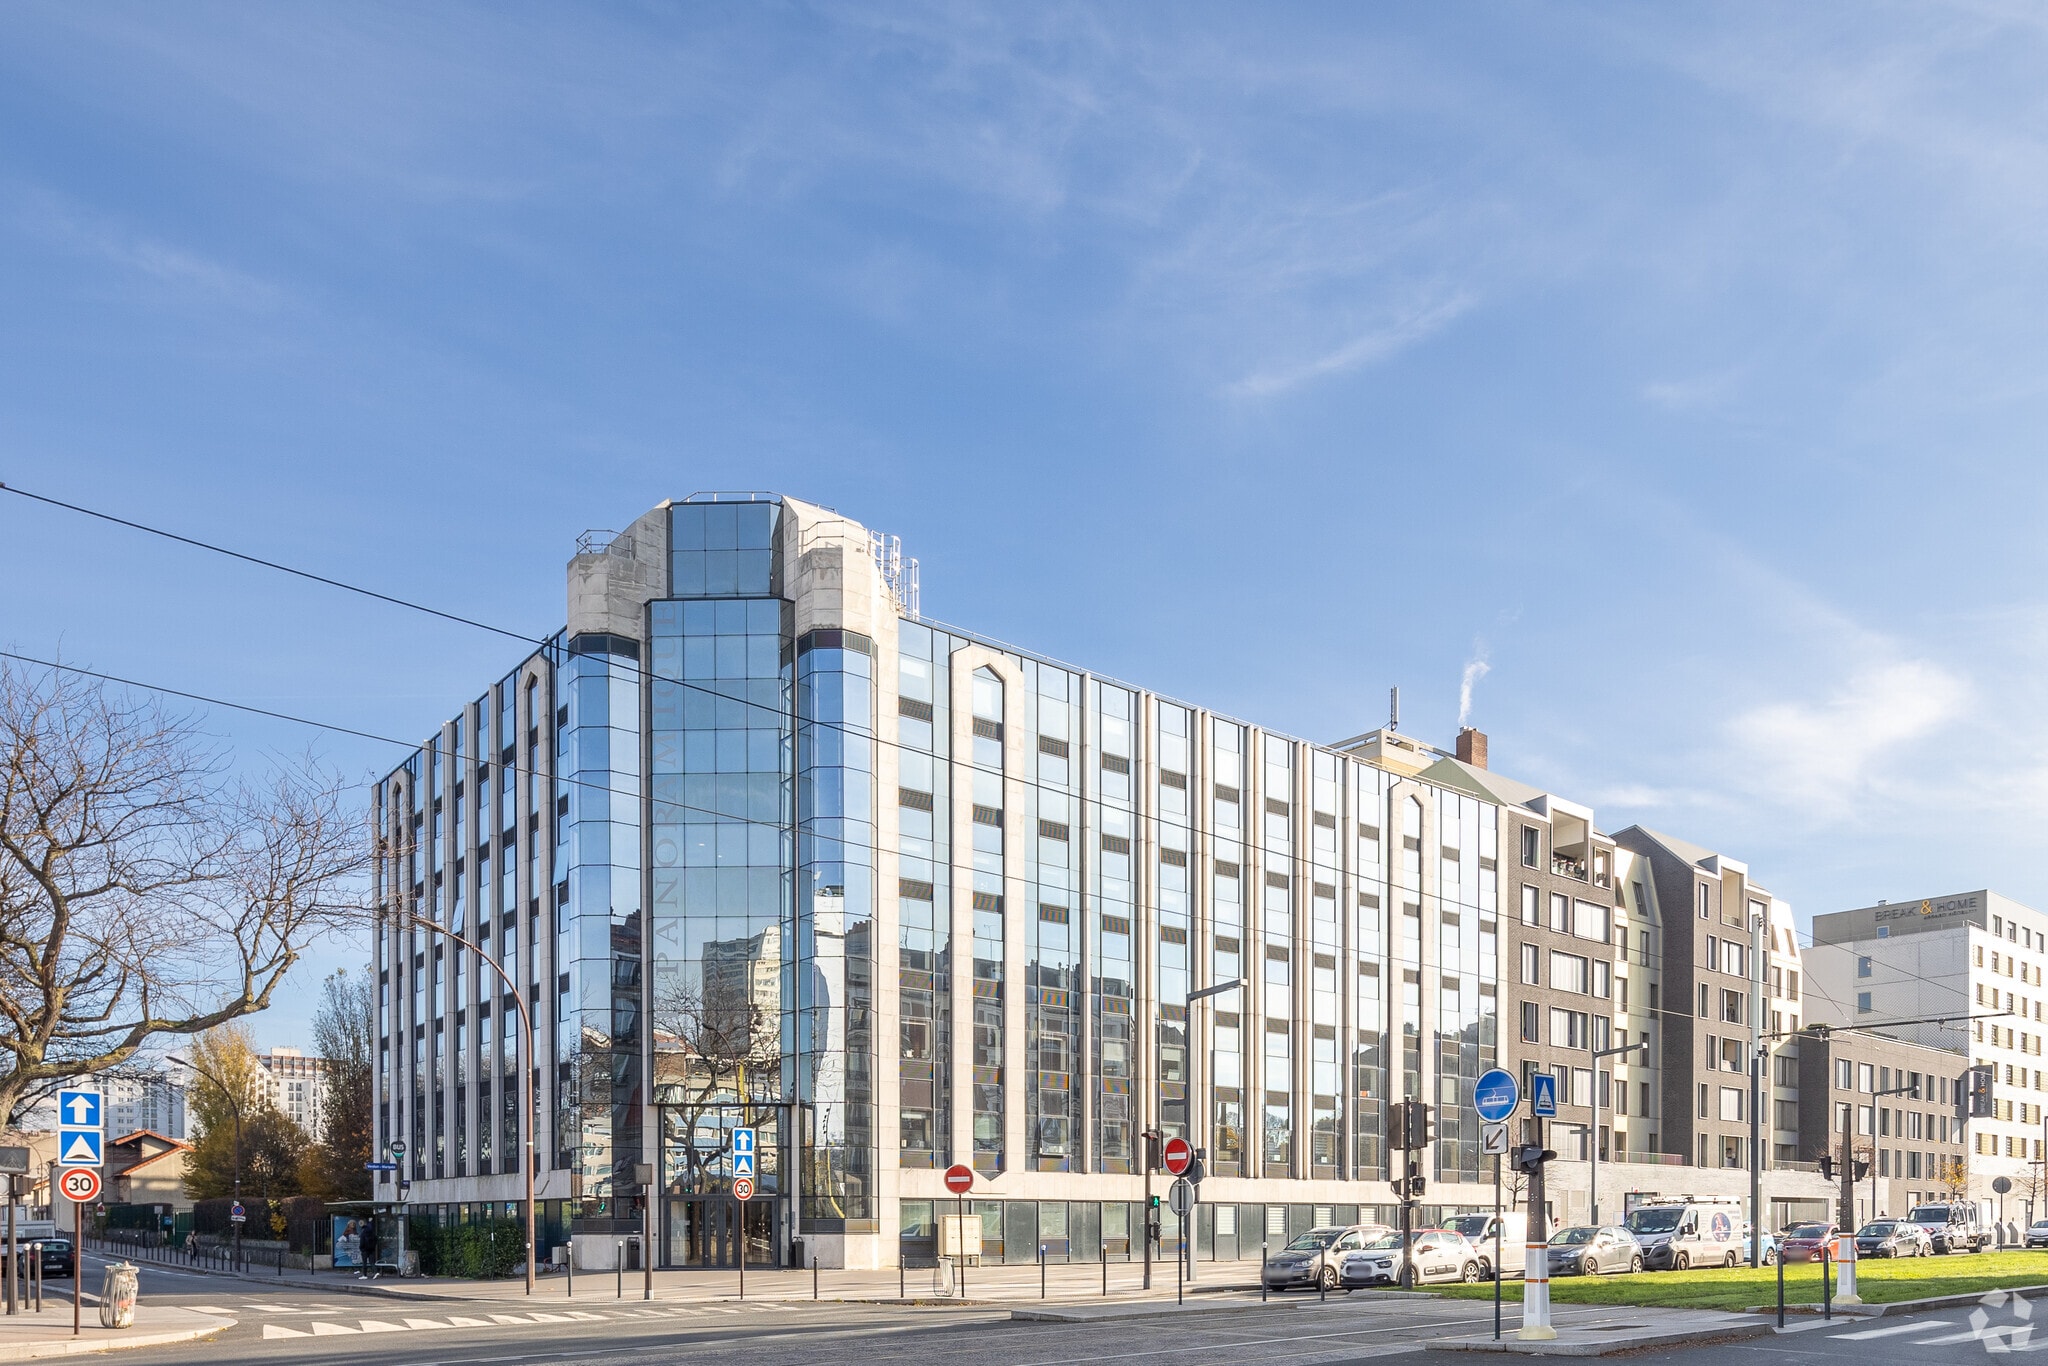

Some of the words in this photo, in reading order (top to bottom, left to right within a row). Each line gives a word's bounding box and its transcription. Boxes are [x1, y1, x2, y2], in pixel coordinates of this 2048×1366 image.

[655, 603, 680, 976] PANORAMIQUE
[1875, 906, 1917, 921] BREAK
[1920, 899, 1933, 915] &
[1936, 897, 1977, 912] HOME
[69, 1177, 92, 1191] 30
[738, 1184, 749, 1193] 30
